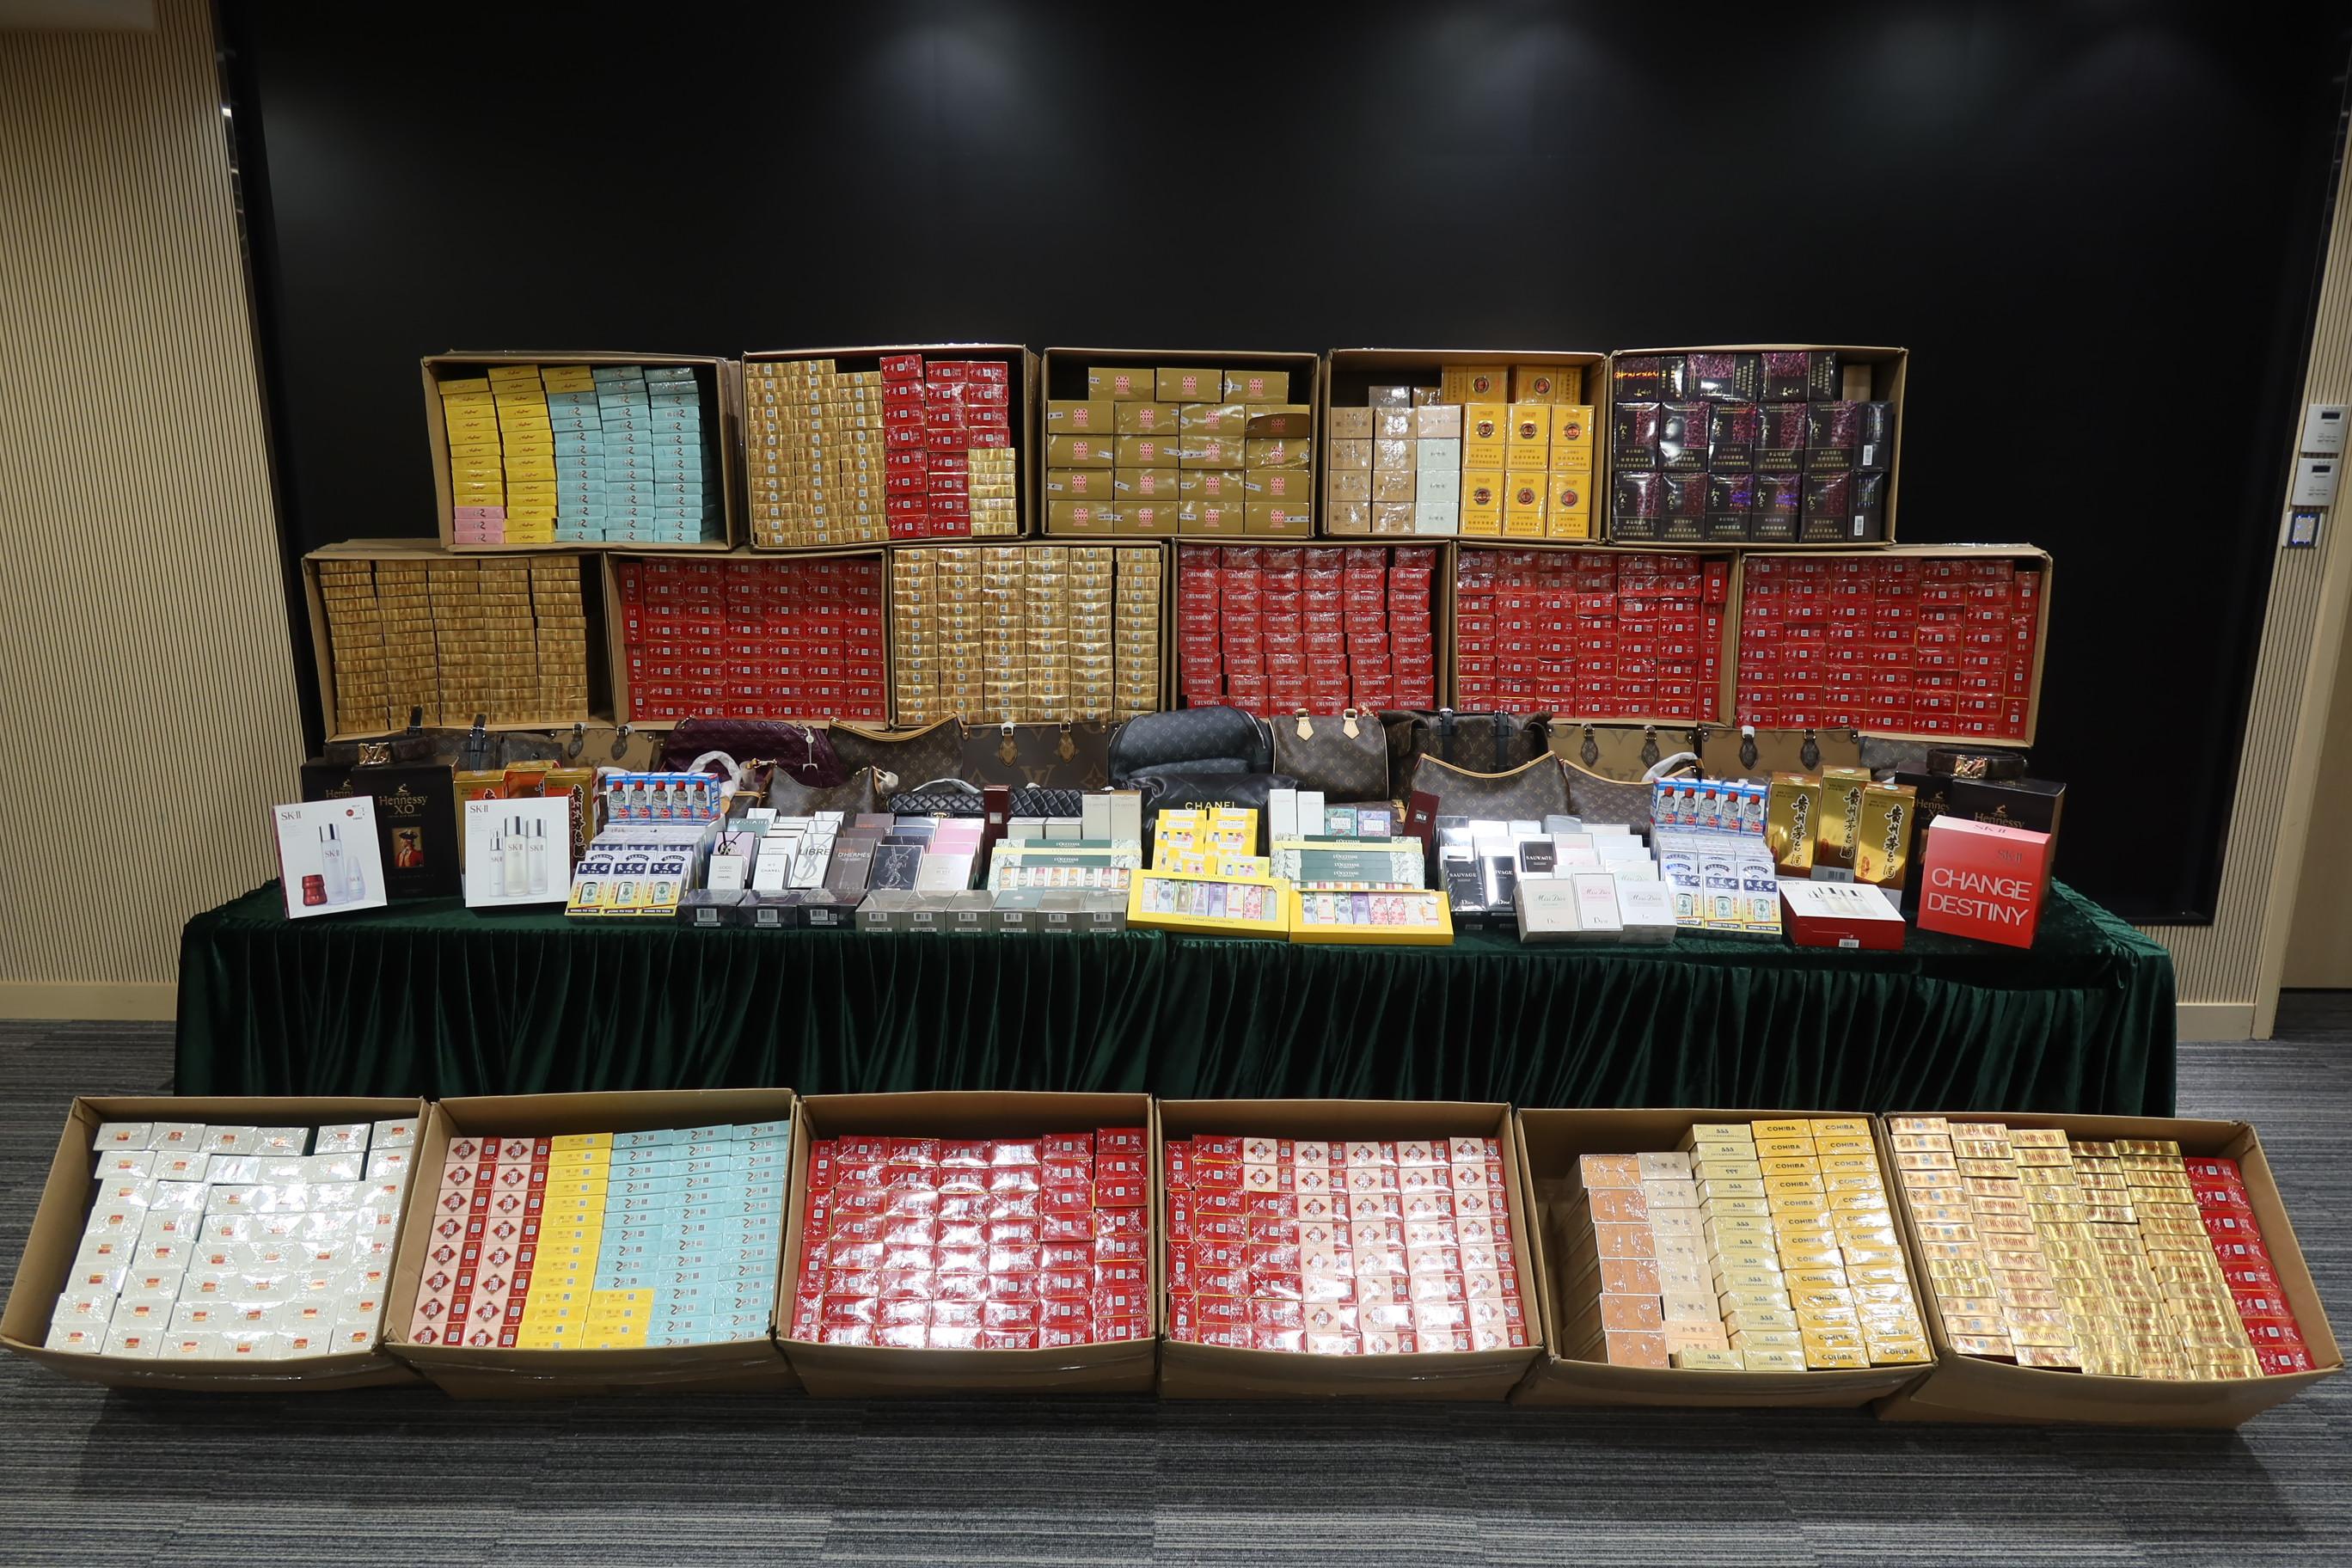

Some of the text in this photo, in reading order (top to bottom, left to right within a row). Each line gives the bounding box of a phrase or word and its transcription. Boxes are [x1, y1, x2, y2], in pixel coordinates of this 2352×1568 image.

[379, 795, 428, 806] Hennessy
[1974, 812, 2024, 829] Hennessy
[799, 848, 830, 856] LIBRE
[1931, 867, 2033, 902] CHANGE
[1926, 893, 2030, 927] DESTINY
